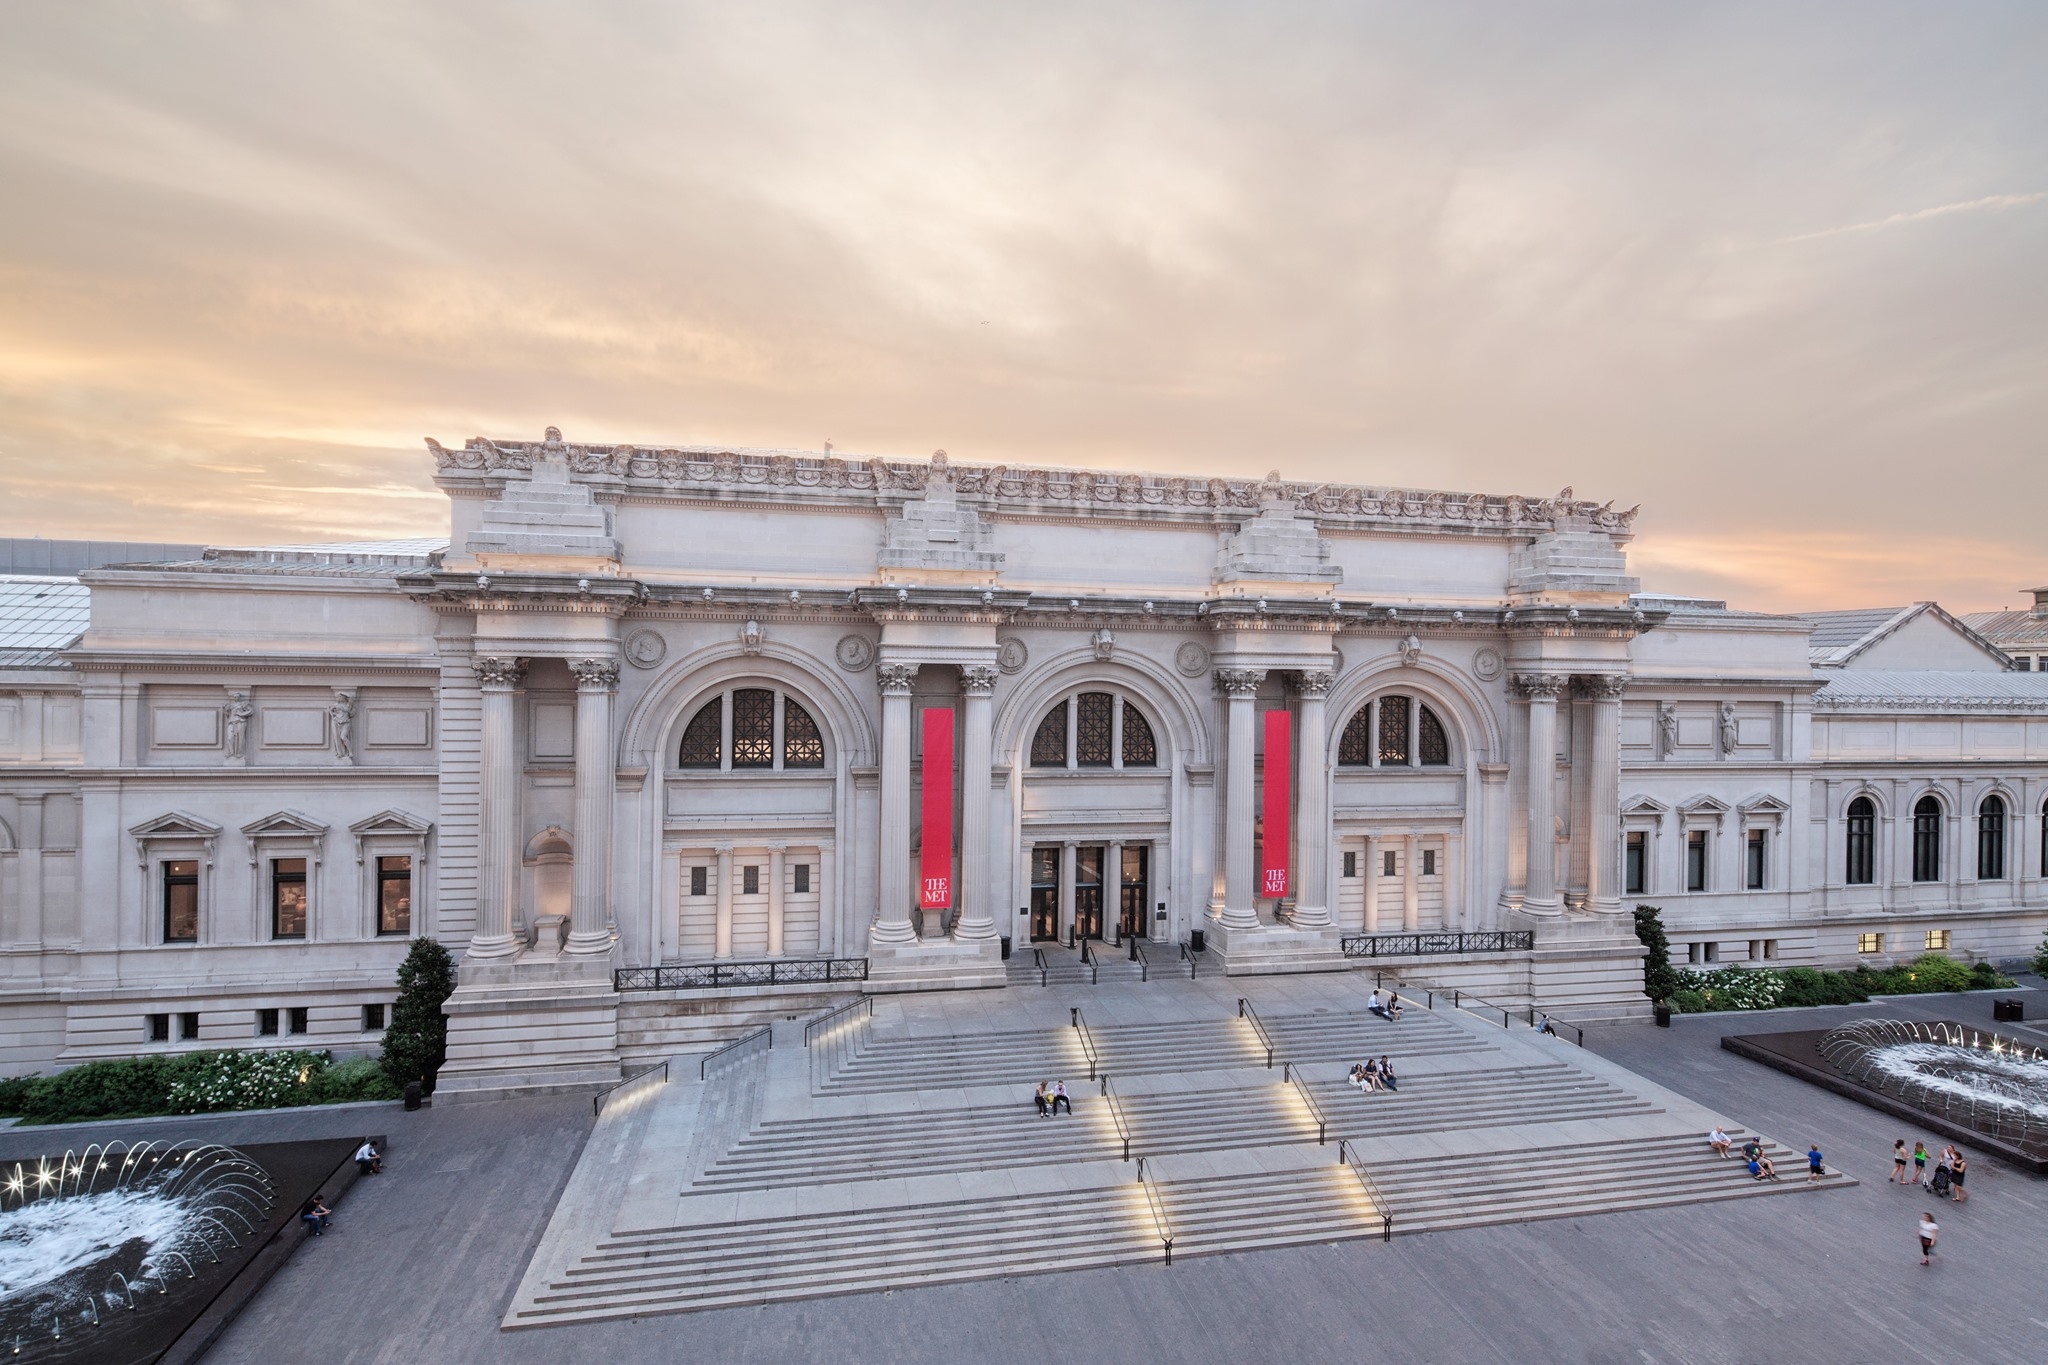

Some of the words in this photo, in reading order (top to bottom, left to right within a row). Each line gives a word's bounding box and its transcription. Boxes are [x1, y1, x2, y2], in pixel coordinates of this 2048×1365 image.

[1266, 869, 1285, 880] THE
[925, 878, 947, 890] THE
[1265, 881, 1285, 892] MET
[924, 890, 947, 902] MET
